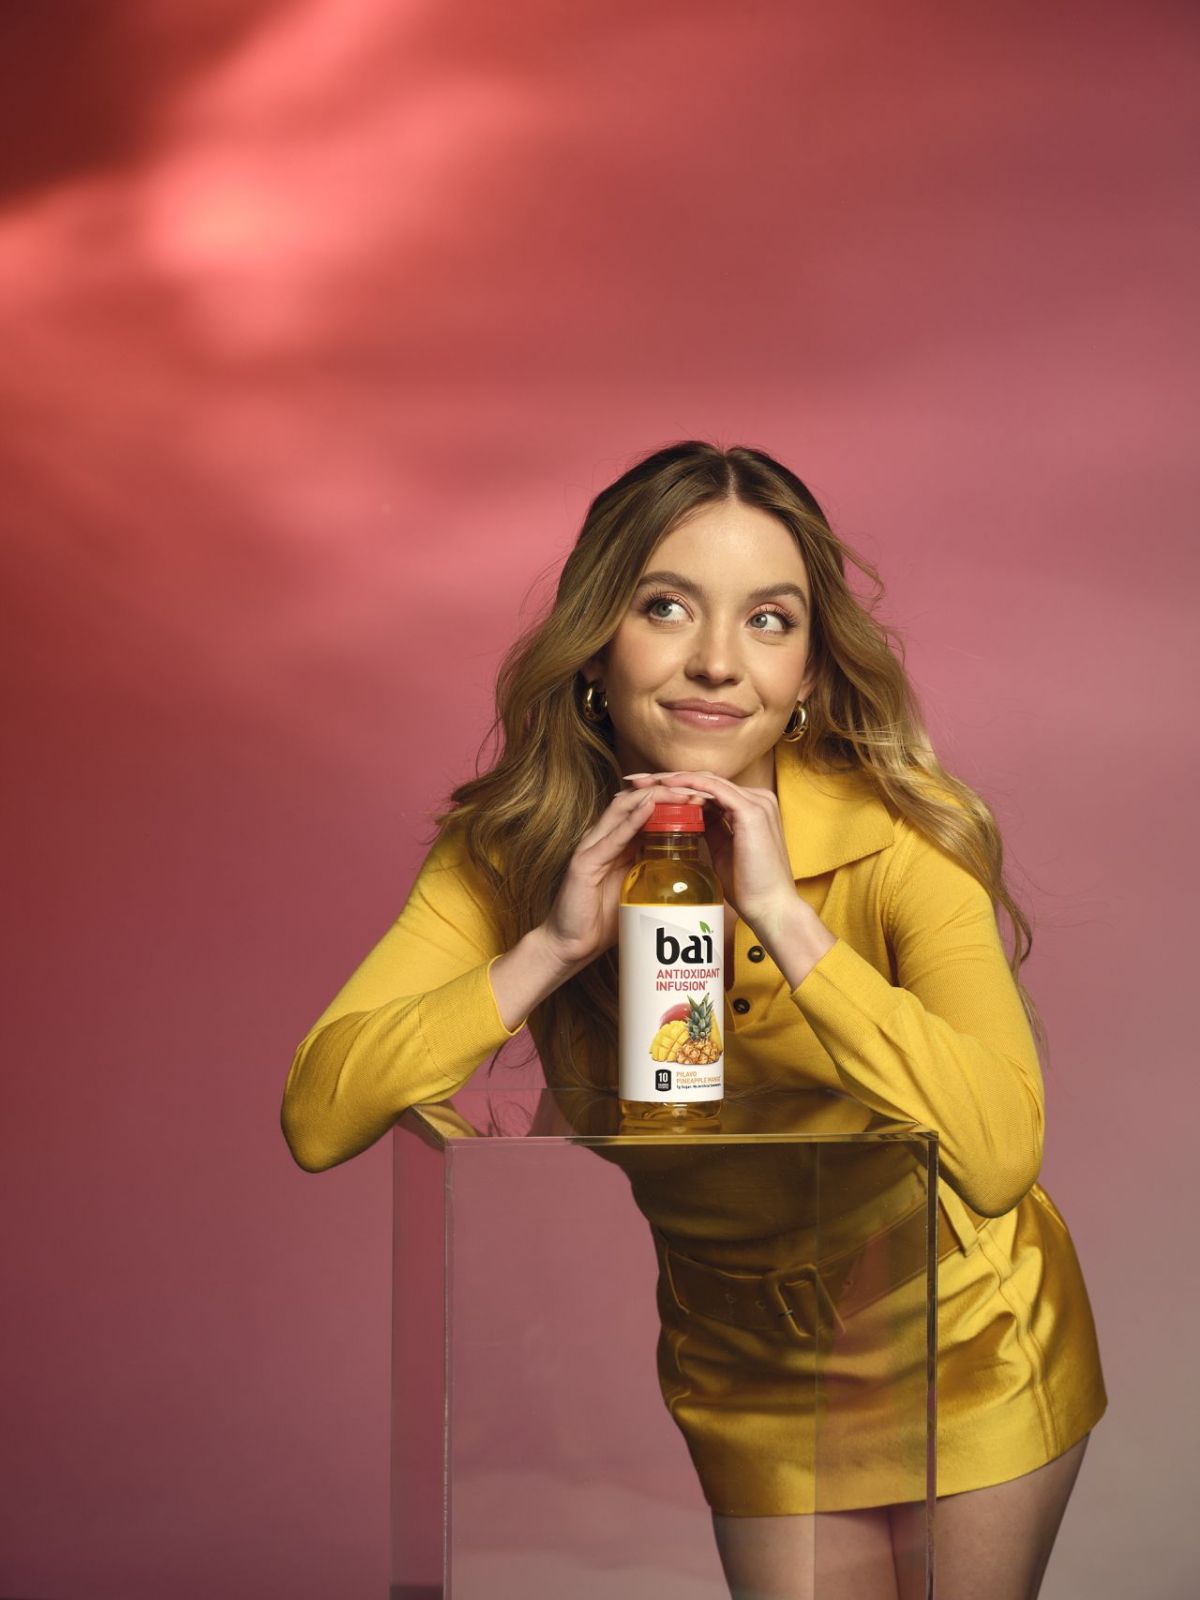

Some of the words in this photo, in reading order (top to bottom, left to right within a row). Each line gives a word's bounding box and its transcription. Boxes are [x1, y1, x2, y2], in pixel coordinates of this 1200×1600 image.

[656, 921, 713, 965] bai
[656, 968, 719, 979] ANTIOXIDANT
[658, 1072, 668, 1082] 10
